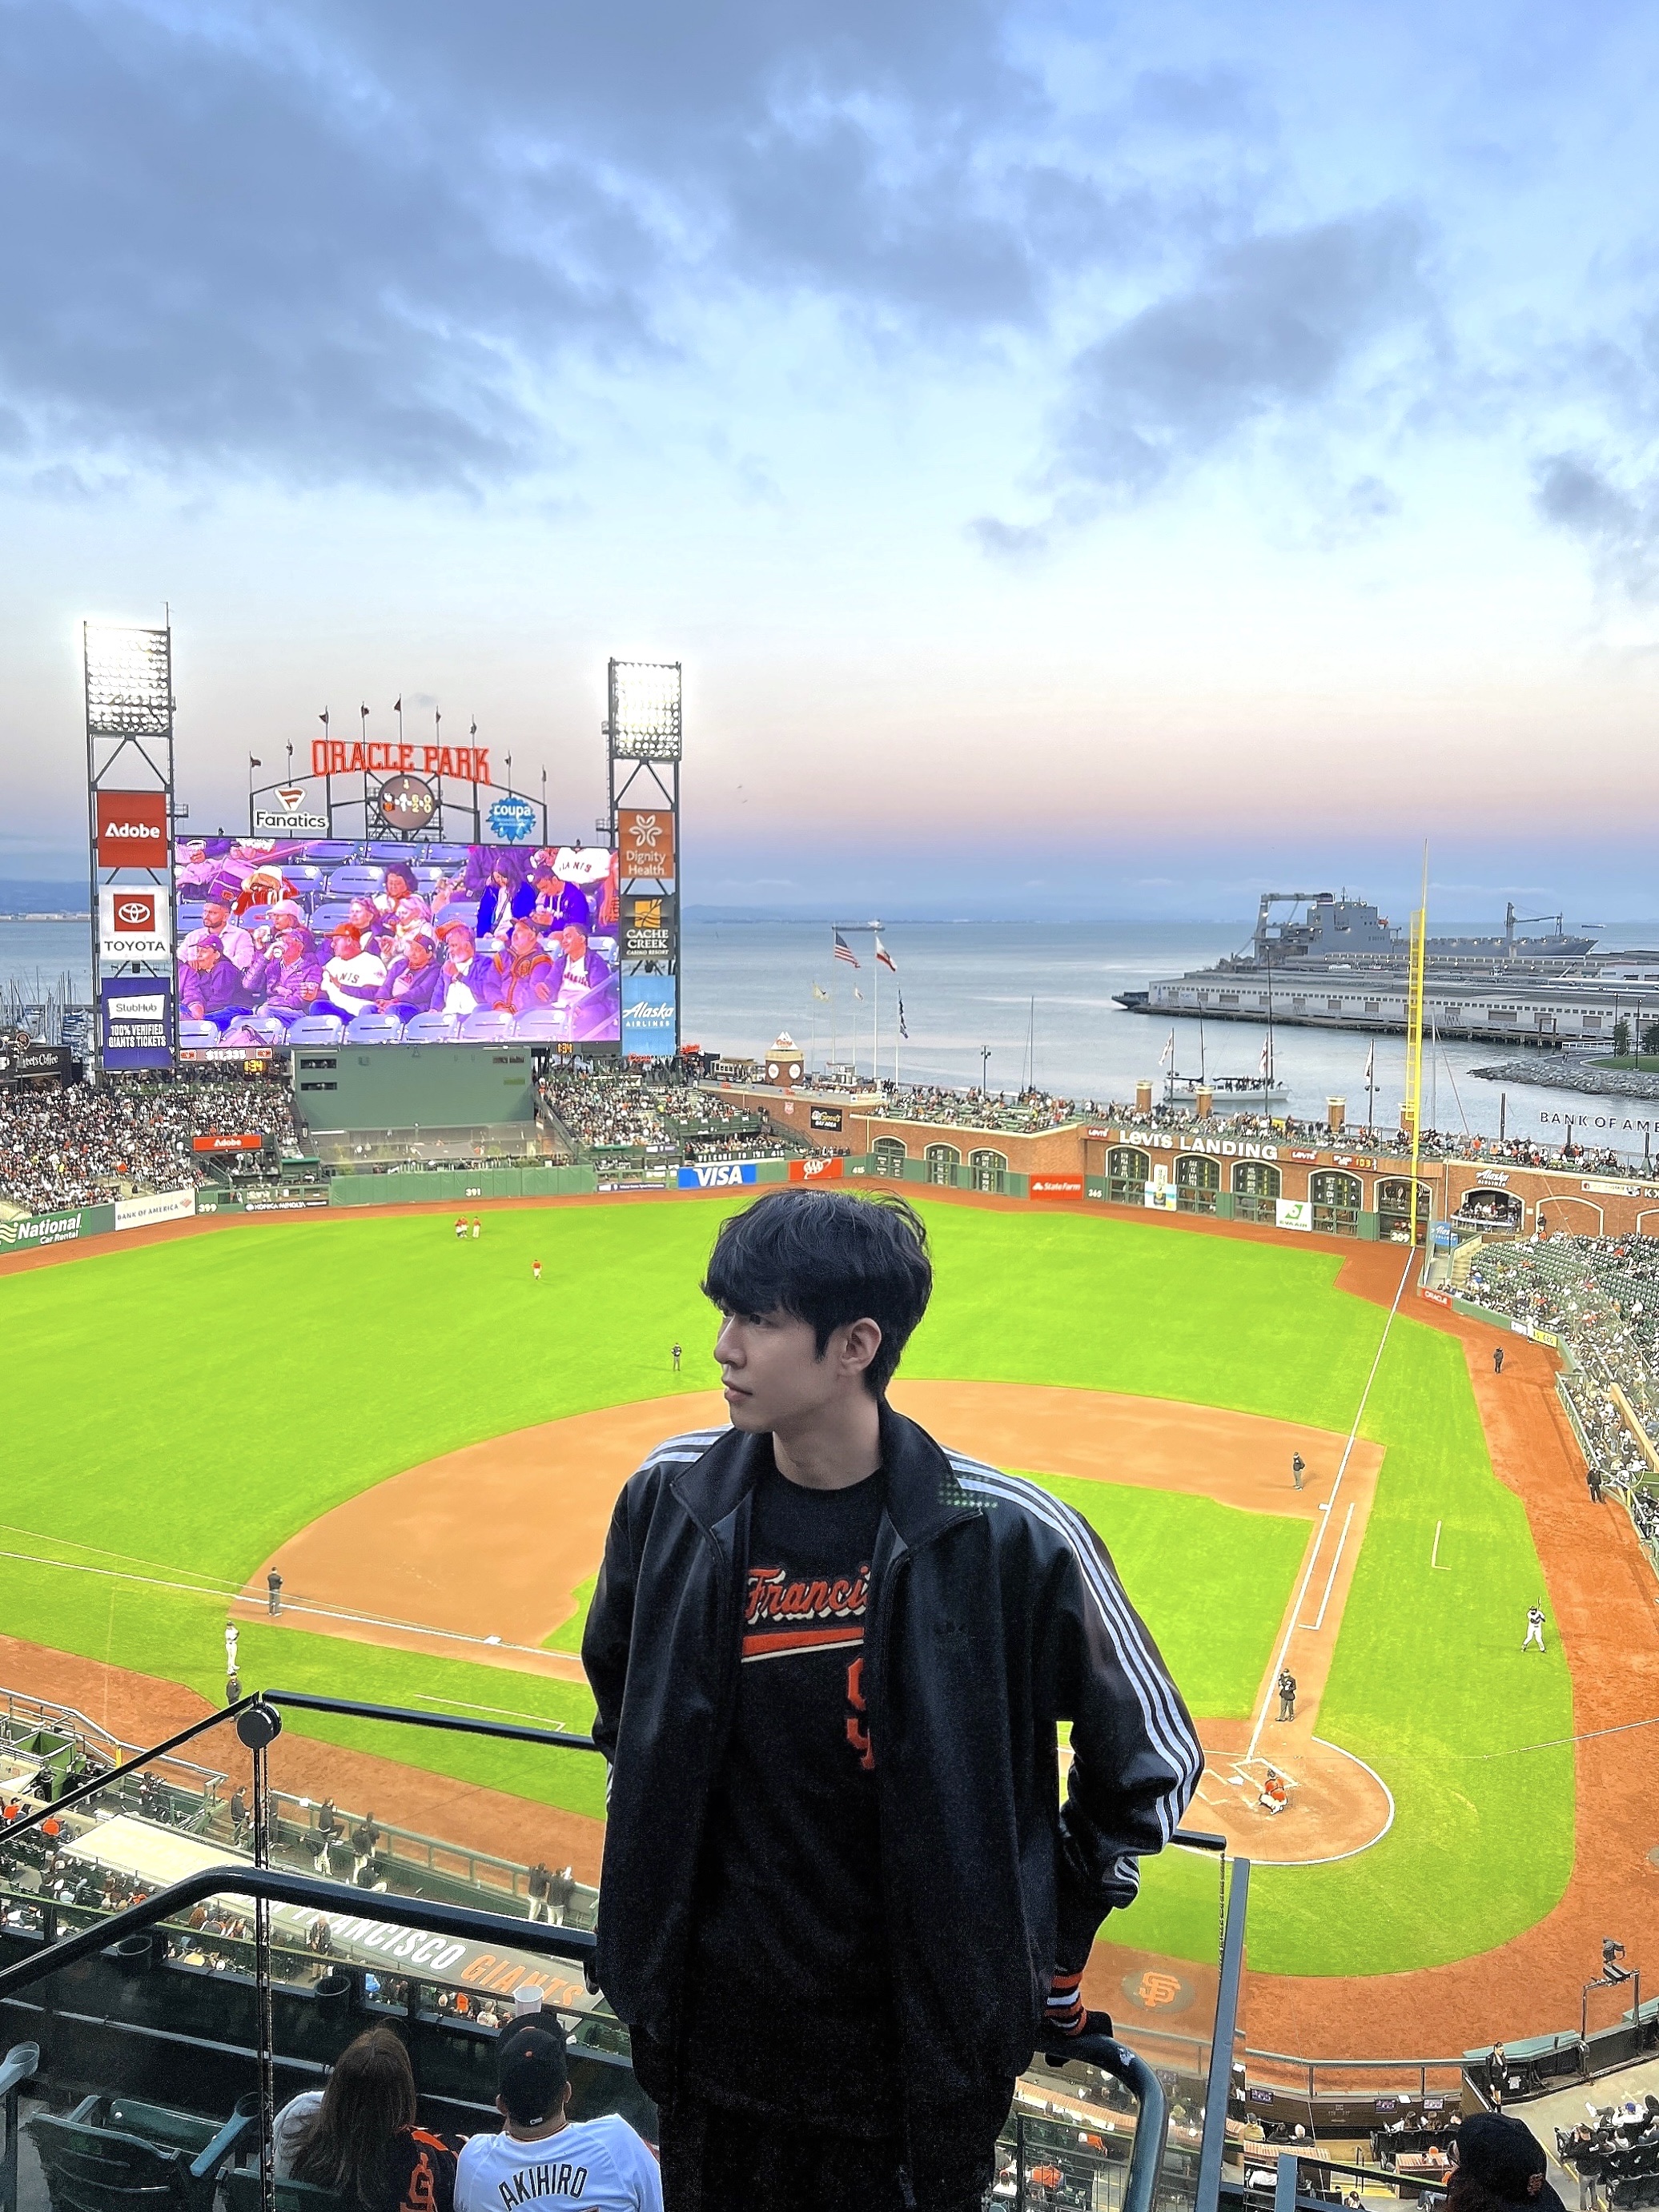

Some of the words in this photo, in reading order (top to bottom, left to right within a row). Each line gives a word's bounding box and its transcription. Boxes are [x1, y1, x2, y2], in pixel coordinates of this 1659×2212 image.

[311, 739, 415, 777] ORACLE
[424, 744, 491, 785] PARK
[255, 811, 327, 829] Fanatics
[493, 805, 532, 822] coupa
[104, 821, 161, 838] Adobe
[625, 849, 666, 865] Dignity
[628, 864, 665, 876] Health
[625, 929, 669, 940] CACHE
[104, 940, 167, 953] TOYOTA
[627, 939, 668, 949] CREEK
[115, 1002, 158, 1013] StubHub
[622, 1001, 674, 1020] Alaska
[110, 1024, 131, 1037] 100%
[131, 1023, 164, 1036] VERIFIED
[108, 1036, 135, 1048] GIANTS
[135, 1035, 167, 1048] TICKETS
[39, 1052, 58, 1066] Coffee
[1540, 1111, 1588, 1126] BANK
[1594, 1117, 1617, 1130] OF
[214, 1138, 242, 1147] Adobe
[1179, 1135, 1279, 1161] LANDING
[693, 1164, 744, 1186] VISA
[1475, 1168, 1510, 1183] Alaska
[465, 1187, 481, 1197] 391
[117, 1210, 137, 1221] BANK
[138, 1208, 148, 1217] OF
[149, 1203, 179, 1215] AMERICA
[198, 1202, 218, 1213] 399
[254, 1202, 279, 1210] KONICA
[279, 1201, 307, 1210] MINOLTA
[17, 1213, 81, 1240] National
[39, 1234, 54, 1246] Car
[54, 1229, 79, 1242] Rental
[1391, 1231, 1411, 1243] 309
[745, 1564, 870, 1625] Franci
[497, 2162, 588, 2212] AKIHIRO
